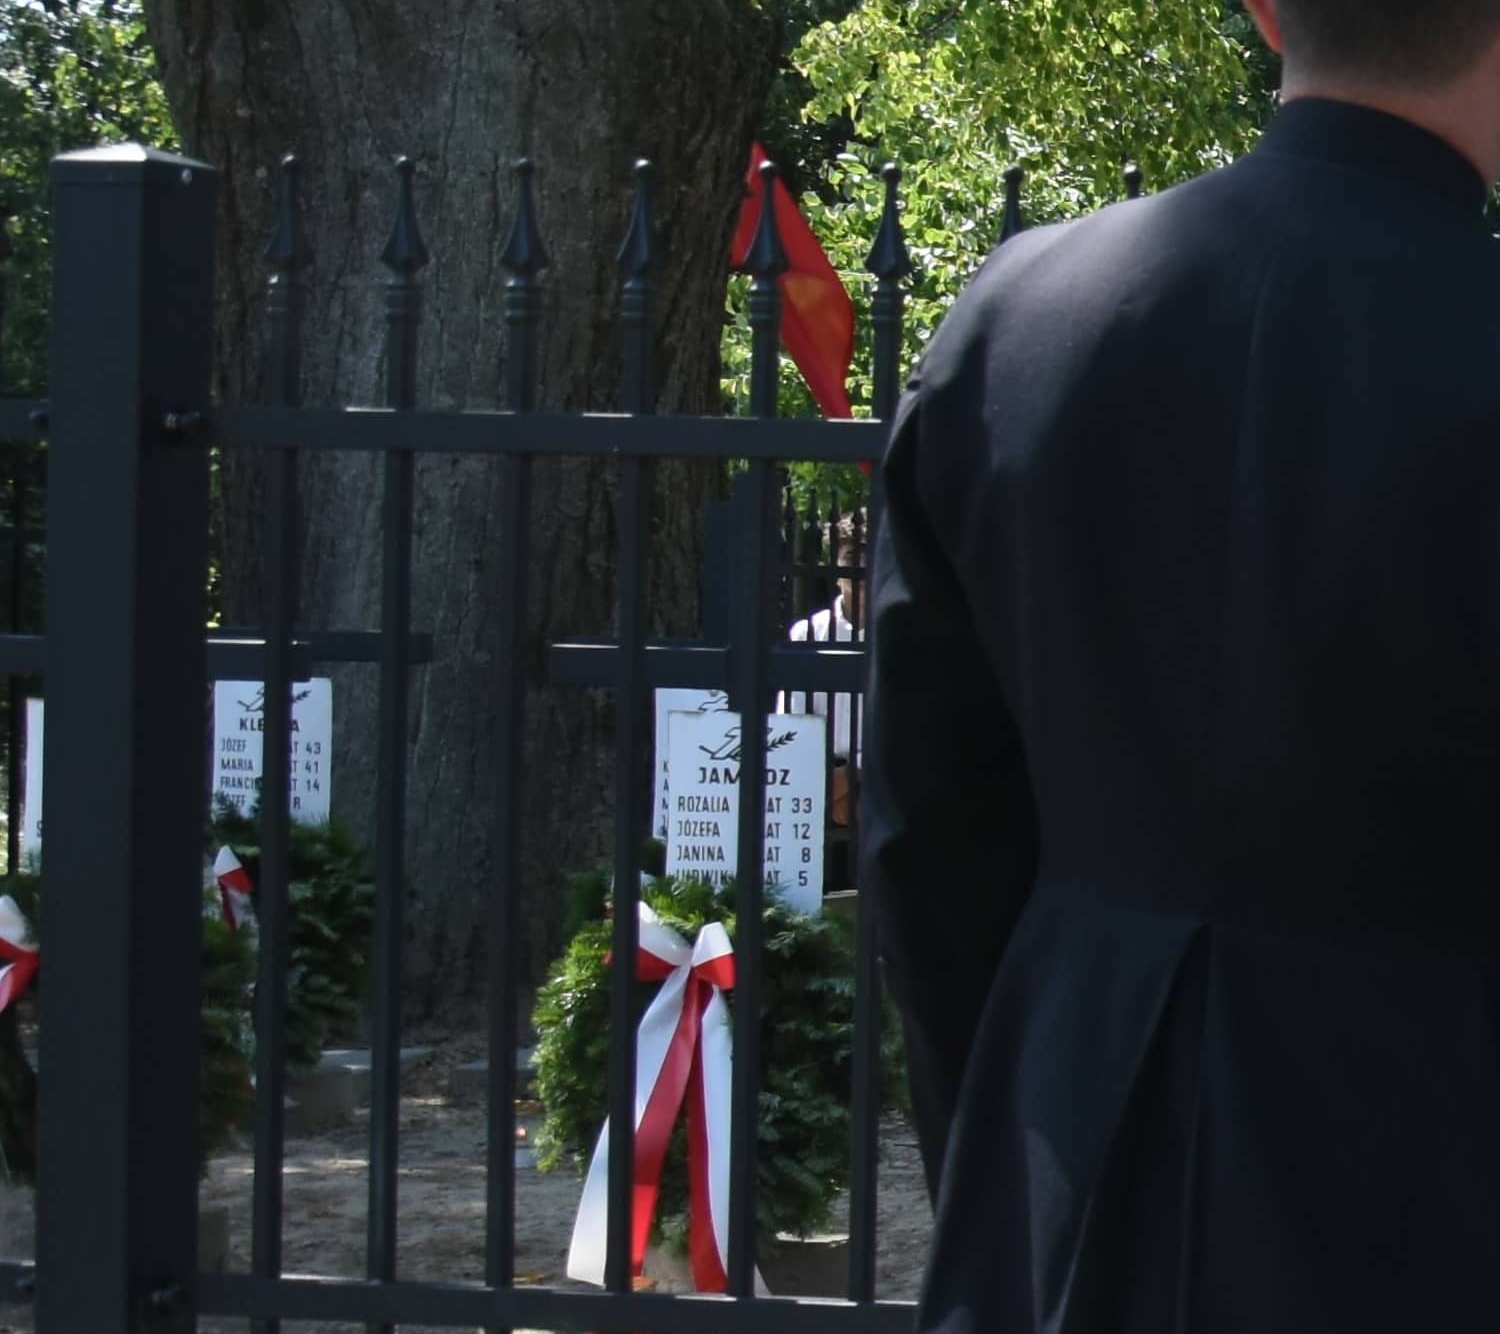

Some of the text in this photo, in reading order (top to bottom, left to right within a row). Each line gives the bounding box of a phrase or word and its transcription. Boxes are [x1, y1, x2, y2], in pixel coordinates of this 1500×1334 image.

[221, 737, 247, 753] JÓZEF
[221, 759, 254, 772] MARIA
[304, 761, 320, 774] 41
[305, 779, 320, 792] 14
[677, 796, 730, 813] ROZALIA
[791, 798, 813, 814] 33
[677, 820, 721, 838] JÓZEFA
[794, 823, 811, 840] 12
[676, 846, 725, 862] JANINA
[801, 847, 812, 864] 8
[798, 870, 808, 887] 5
